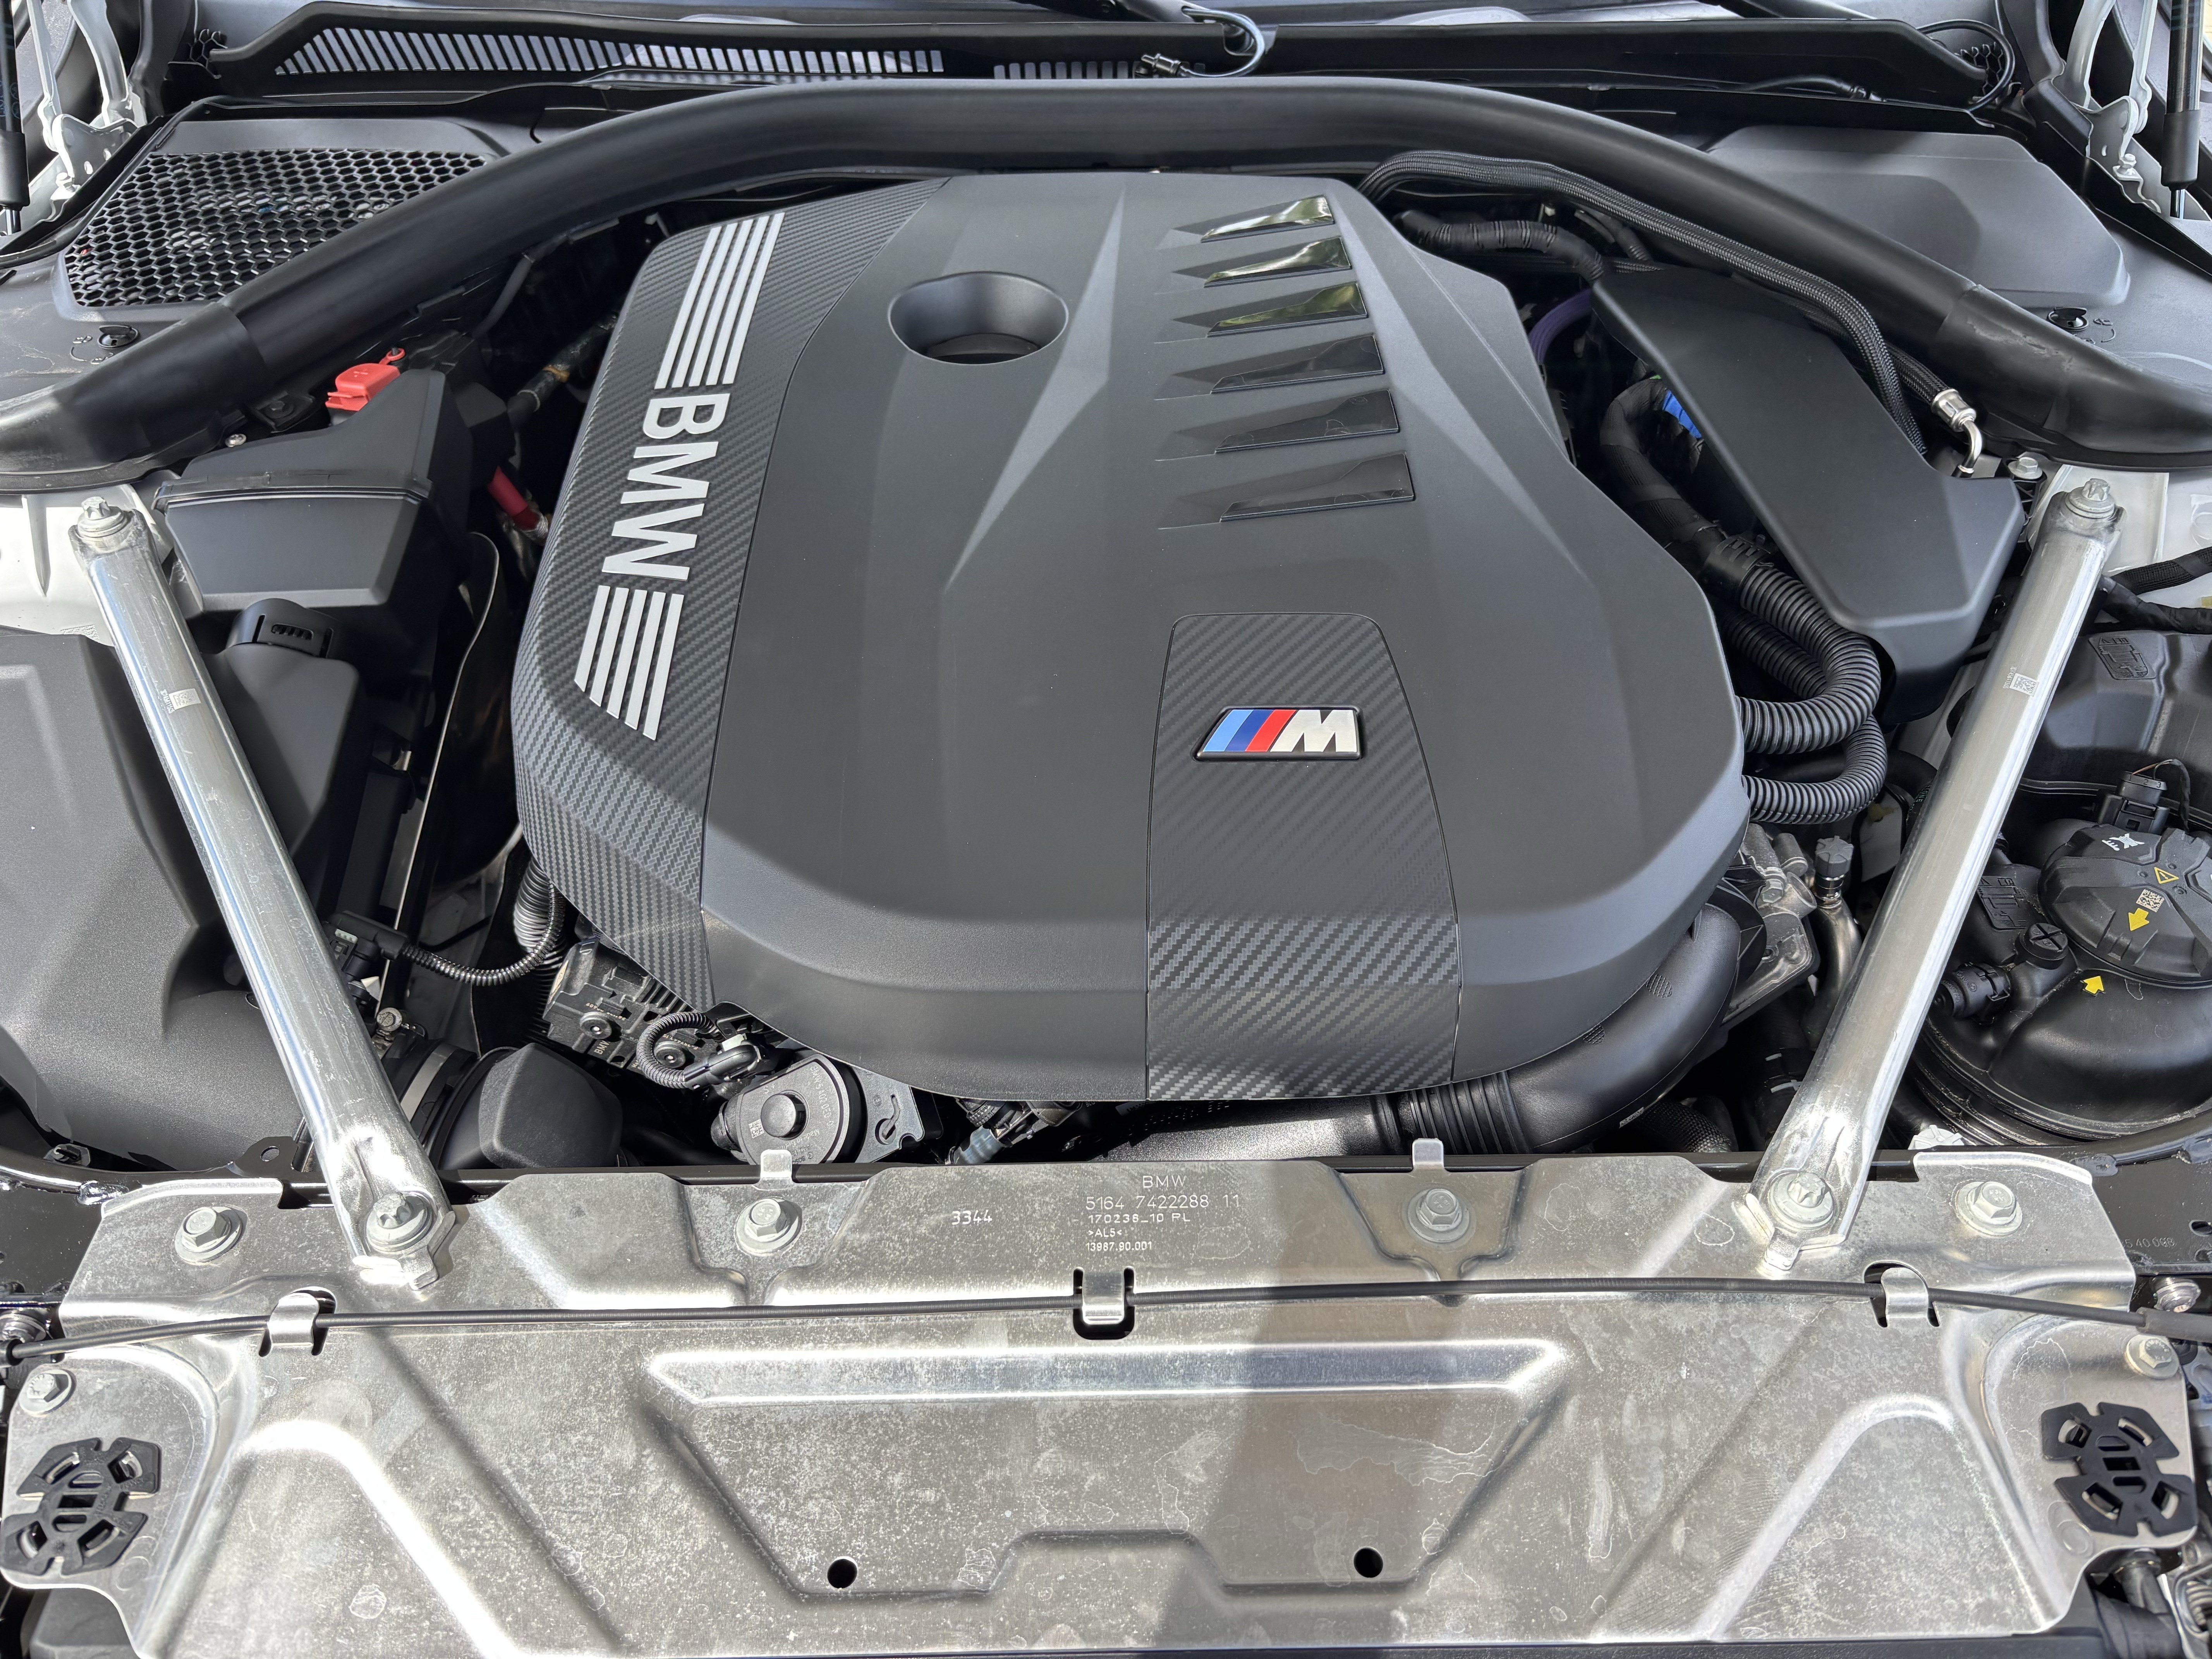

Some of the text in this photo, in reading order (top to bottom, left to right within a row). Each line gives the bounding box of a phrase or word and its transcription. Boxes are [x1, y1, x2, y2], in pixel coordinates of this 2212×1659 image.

[601, 393, 730, 580] BMW
[1142, 1175, 1187, 1188] BMW
[1085, 1194, 1240, 1210] 5164 7422288 11
[951, 1209, 993, 1225] 3344
[1171, 1212, 1191, 1222] PL
[1088, 1228, 1122, 1238] >AL5<
